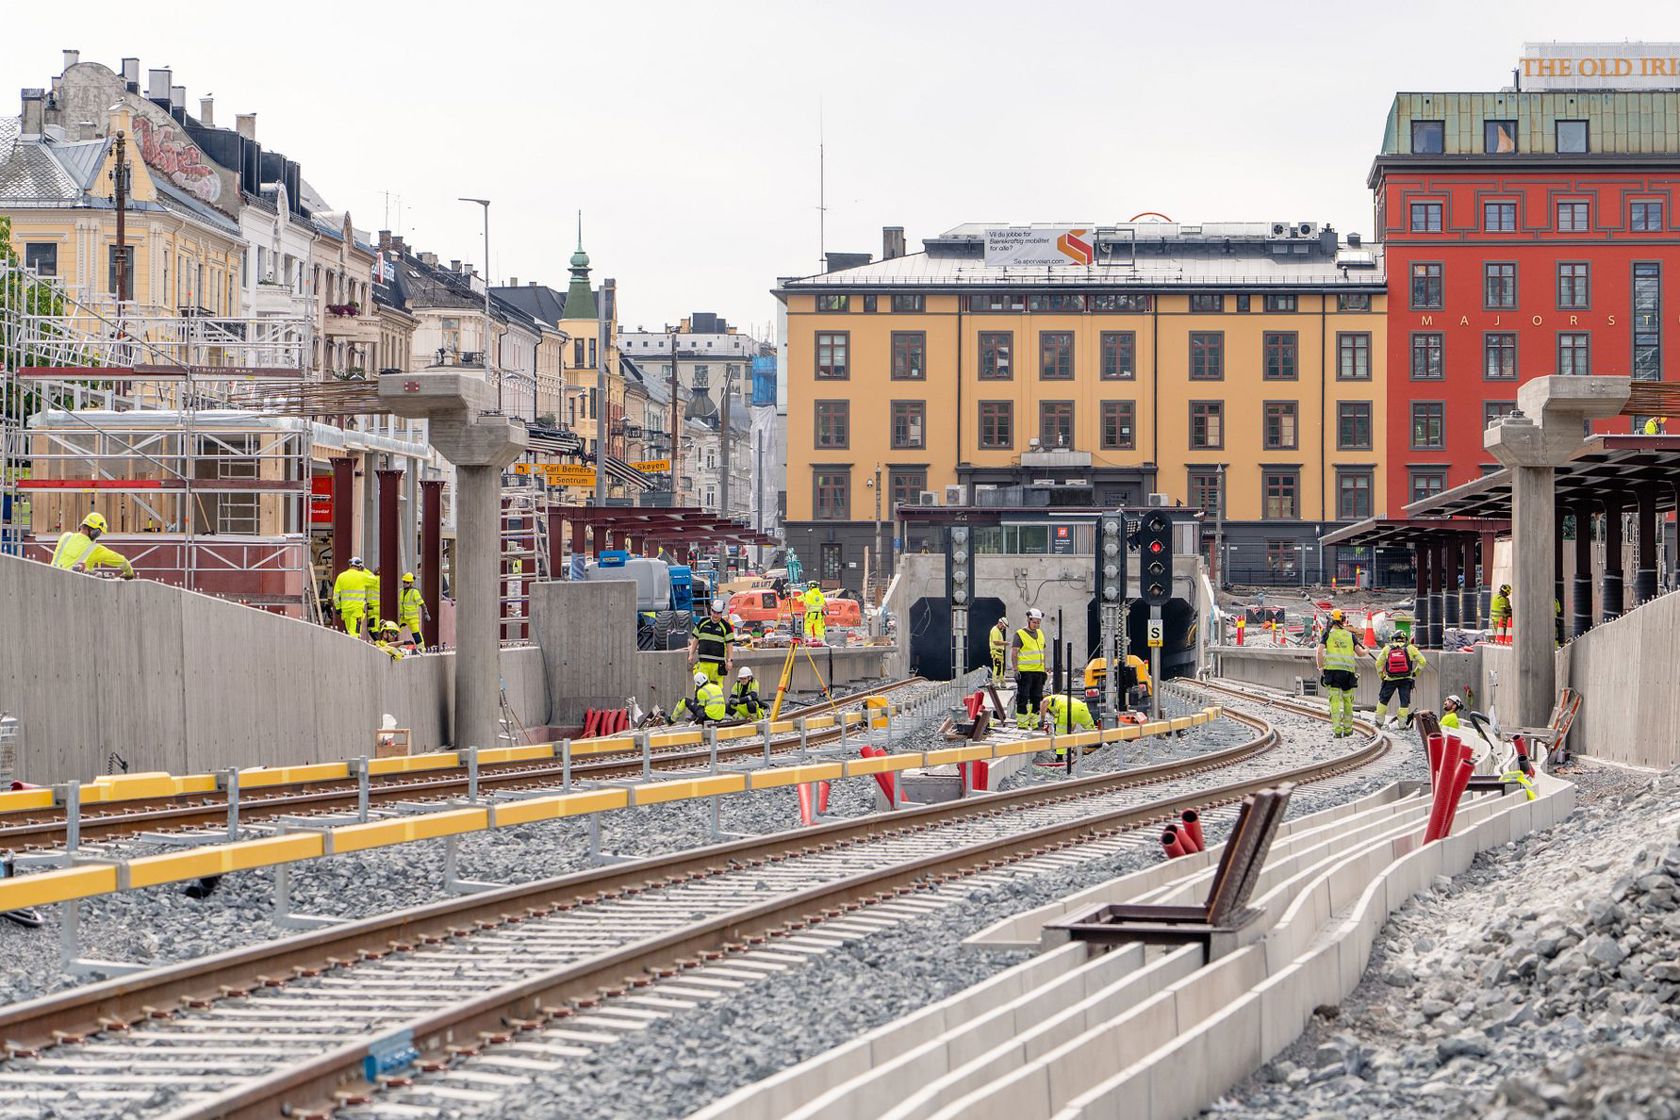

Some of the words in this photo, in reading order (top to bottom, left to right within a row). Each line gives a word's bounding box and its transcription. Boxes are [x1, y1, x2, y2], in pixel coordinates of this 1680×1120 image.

[1520, 57, 1572, 77] THE
[1579, 57, 1632, 77] OLD
[1639, 57, 1680, 76] IRI
[544, 464, 559, 474] Carl
[562, 466, 591, 474] Berners
[556, 476, 588, 485] Sentrum
[1151, 628, 1160, 638] S
